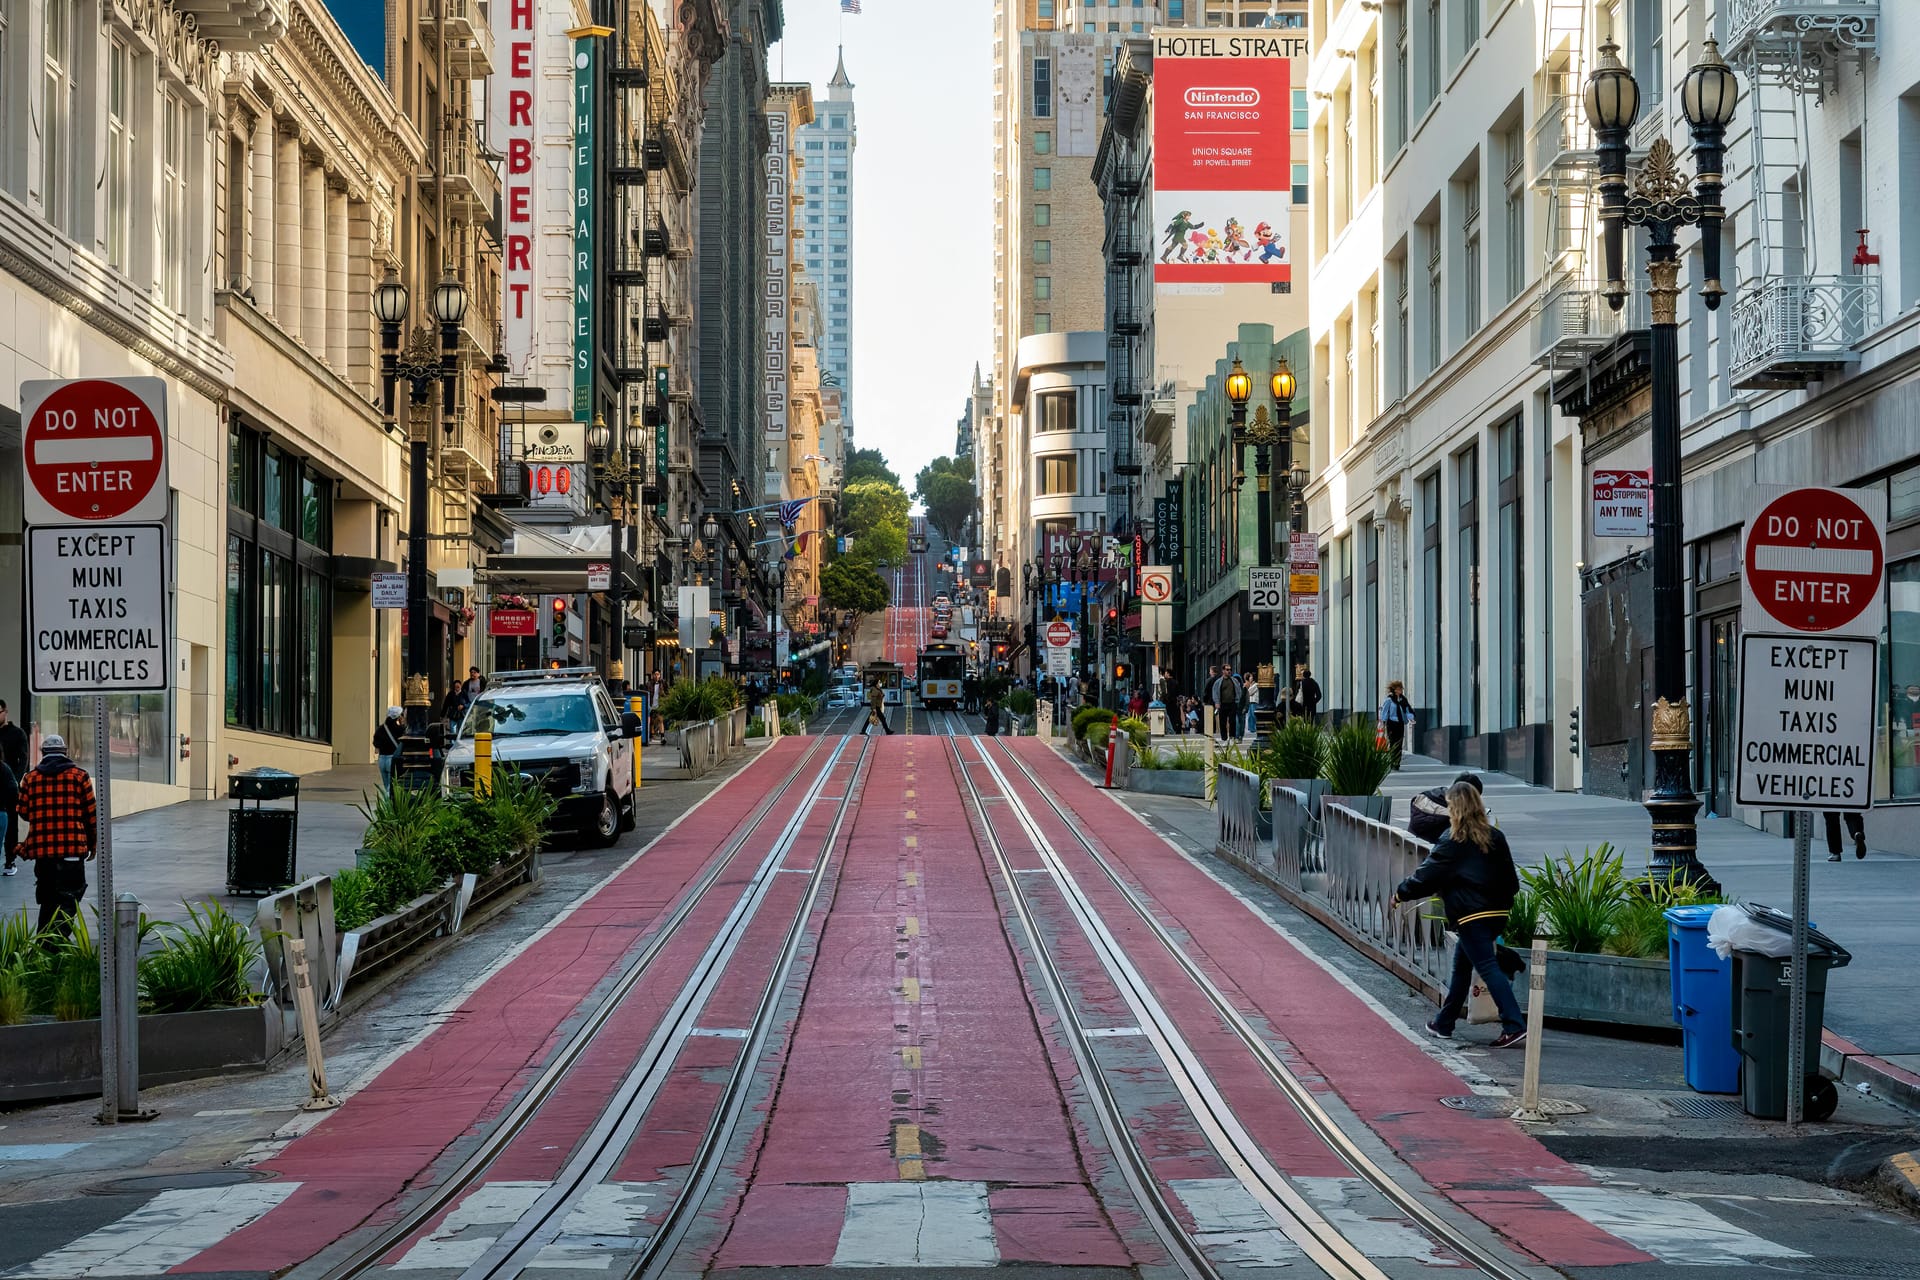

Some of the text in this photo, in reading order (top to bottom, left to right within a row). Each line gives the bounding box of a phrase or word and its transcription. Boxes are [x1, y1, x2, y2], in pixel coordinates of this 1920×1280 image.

[1158, 38, 1308, 57] HOTEL STRATF
[1191, 92, 1253, 103] Nintendo
[578, 85, 589, 165] THE
[1184, 111, 1260, 120] SAN FRANCISCO
[508, 0, 533, 318] HERBERT
[1192, 148, 1253, 156] UNION SQUARE
[766, 115, 785, 318] CHANCELLOR
[578, 188, 589, 369] BARNES
[766, 332, 785, 432] HOTEL
[46, 407, 140, 431] DO NOT
[57, 470, 133, 493] ENTER
[1169, 485, 1179, 520] WINE
[1596, 490, 1647, 500] NO STOPPING
[1600, 506, 1643, 518] ANY TIME
[1290, 534, 1300, 543] NO
[1768, 515, 1863, 541] DO NOT
[58, 536, 135, 557] EXCEPT
[1169, 525, 1179, 559] SHOP
[73, 567, 122, 588] MUNI
[1251, 572, 1281, 580] SPEED
[1253, 590, 1280, 606] 20
[1775, 580, 1850, 604] ENTER
[69, 598, 127, 619] TAXIS
[39, 629, 158, 651] COMMERCIAL
[1771, 646, 1848, 670] EXCEPT
[50, 660, 149, 682] VEHICLES
[1785, 679, 1834, 701] MUNI
[1780, 710, 1837, 733] TAXIS
[1747, 741, 1865, 767] COMMERCIAL
[1756, 773, 1855, 798] VEHICLES
